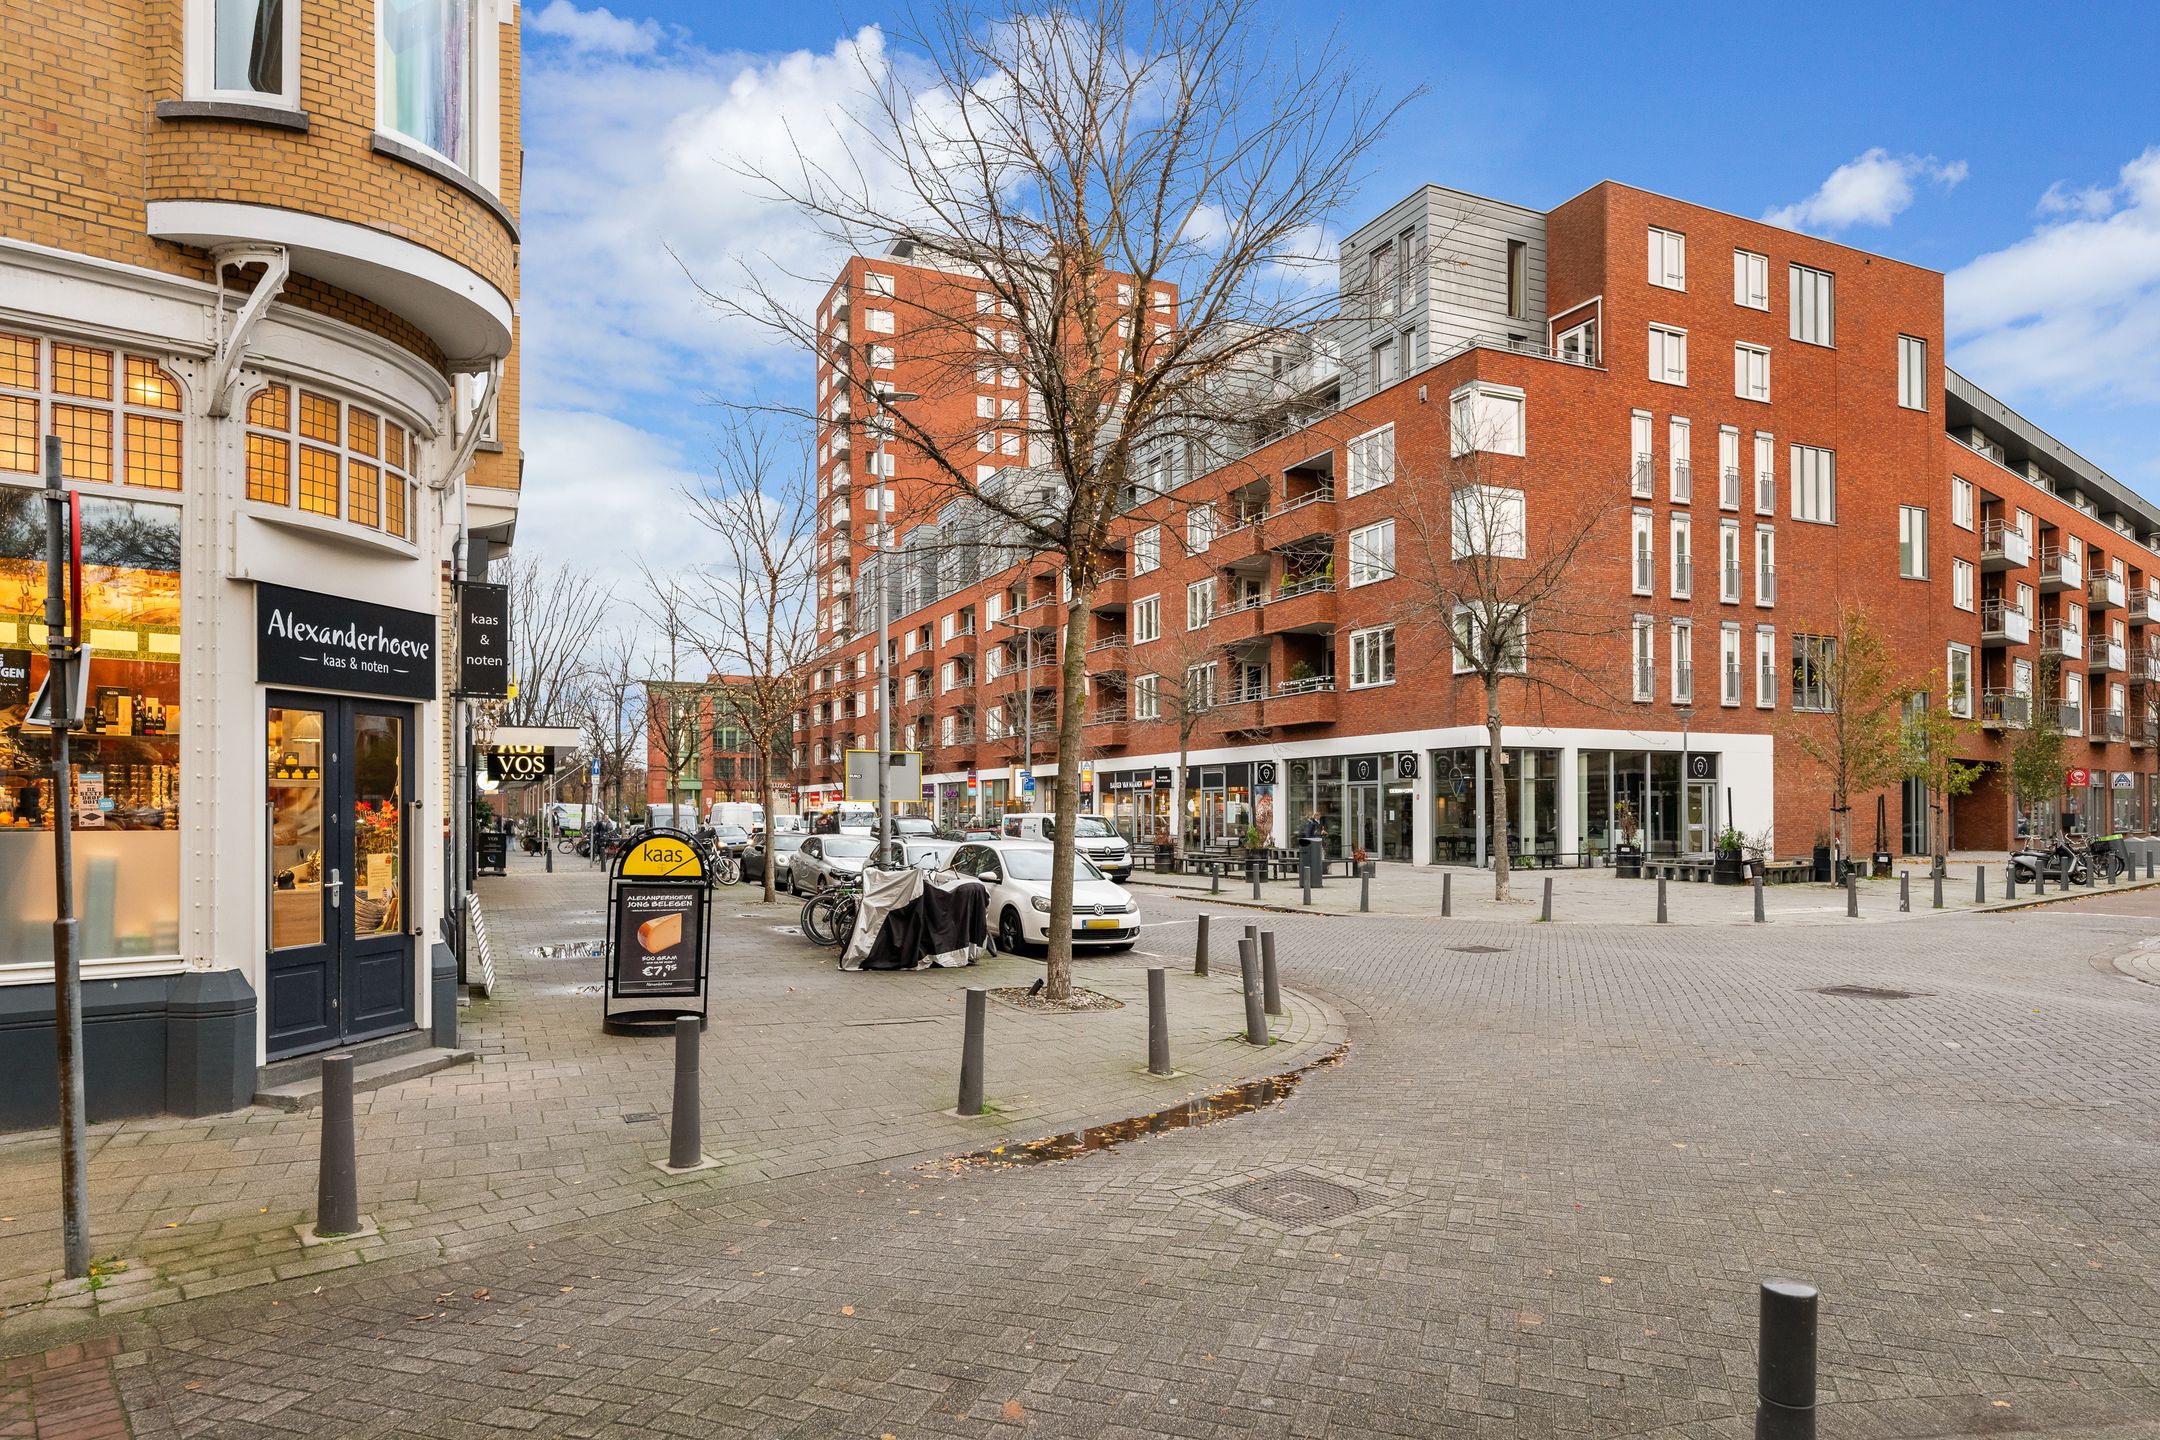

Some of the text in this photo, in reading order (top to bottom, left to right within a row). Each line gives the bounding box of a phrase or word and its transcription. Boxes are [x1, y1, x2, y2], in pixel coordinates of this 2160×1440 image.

[472, 612, 499, 626] kaas
[267, 608, 430, 660] Alexanderhoeve
[479, 634, 490, 646] &
[322, 652, 389, 674] kaas & noten
[466, 655, 503, 667] noten
[0, 667, 25, 679] GEN
[496, 755, 546, 774] VOS
[643, 843, 683, 863] kaas
